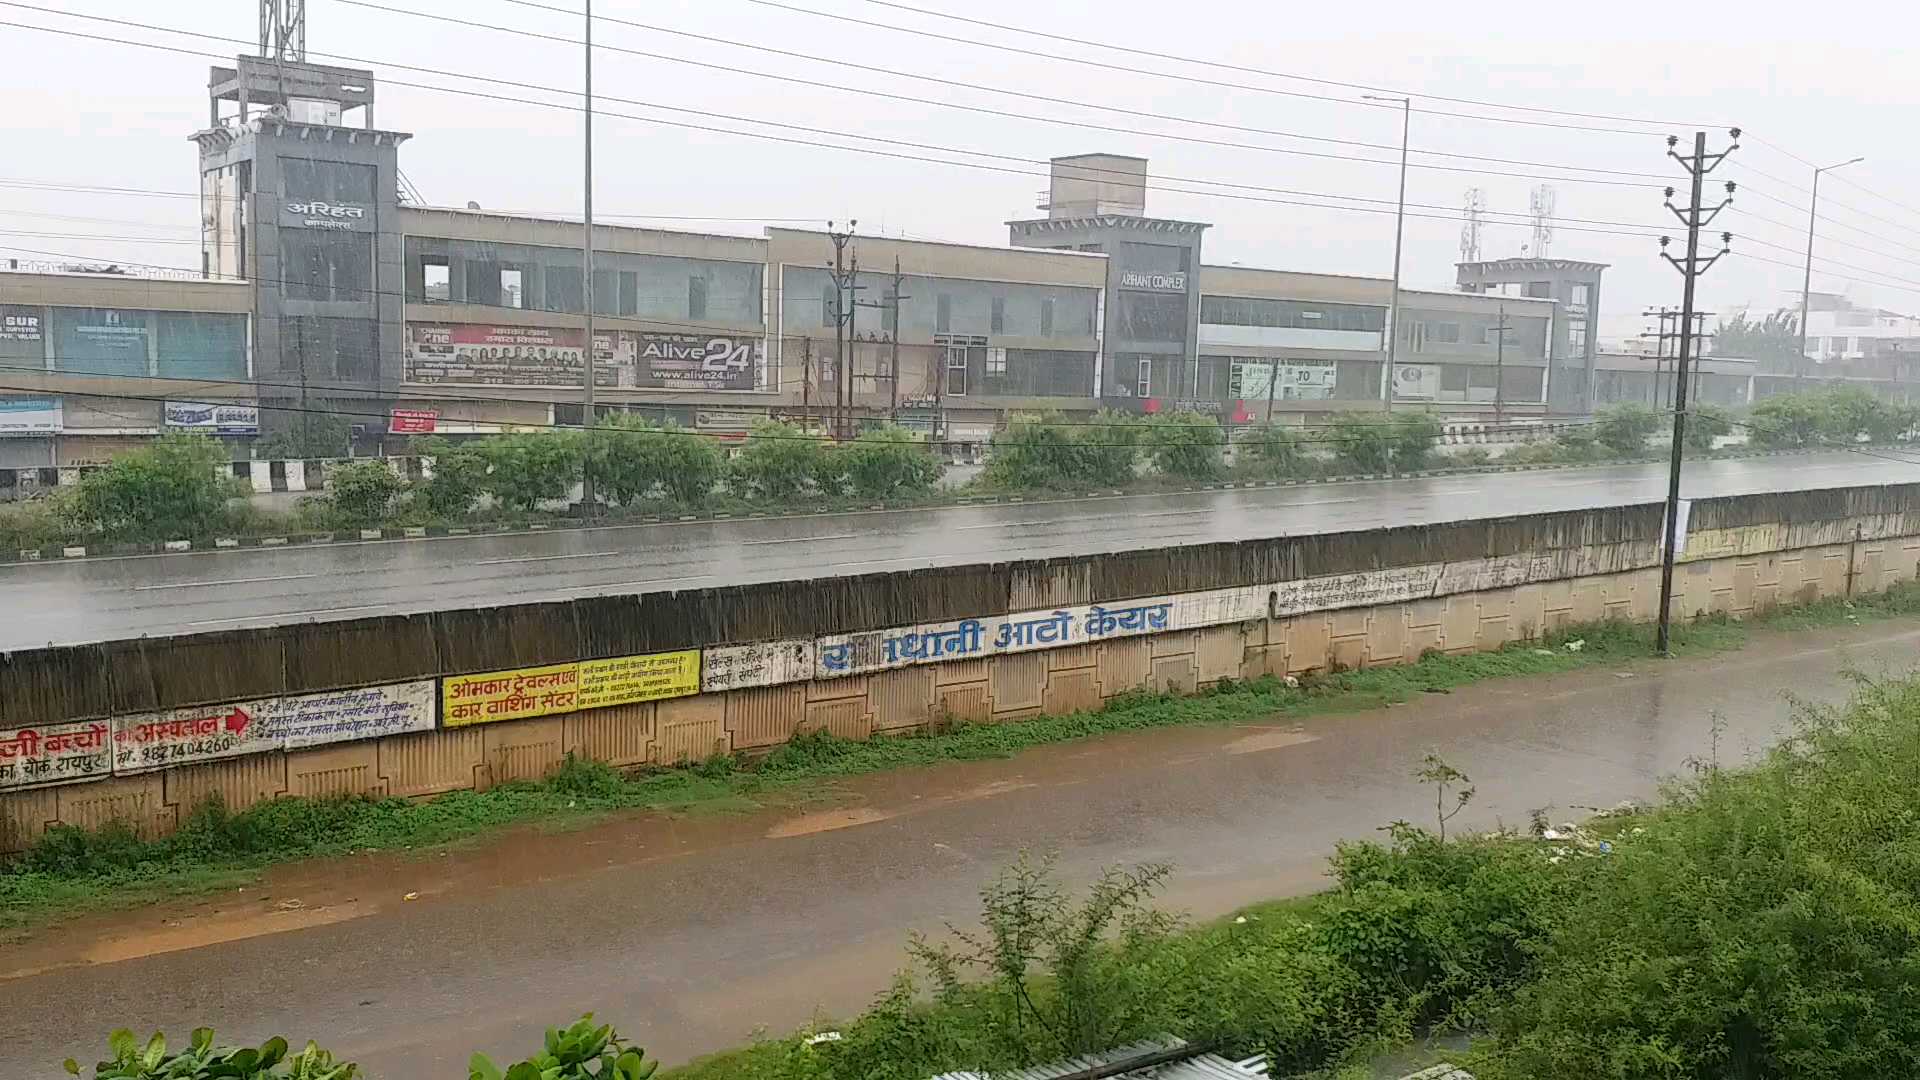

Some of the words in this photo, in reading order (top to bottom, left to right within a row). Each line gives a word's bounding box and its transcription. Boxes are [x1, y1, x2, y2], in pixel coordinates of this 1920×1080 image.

[287, 201, 364, 218] अरिहंत
[1121, 273, 1152, 288] ARIHANT
[1152, 275, 1185, 289] COMPLEX
[651, 371, 738, 381] www.alive24.in
[451, 680, 510, 700] ओमकार
[451, 703, 483, 720] कार
[486, 695, 538, 716] वाशिंग
[45, 723, 109, 752] बच्चों
[134, 716, 222, 743] अस्पताल
